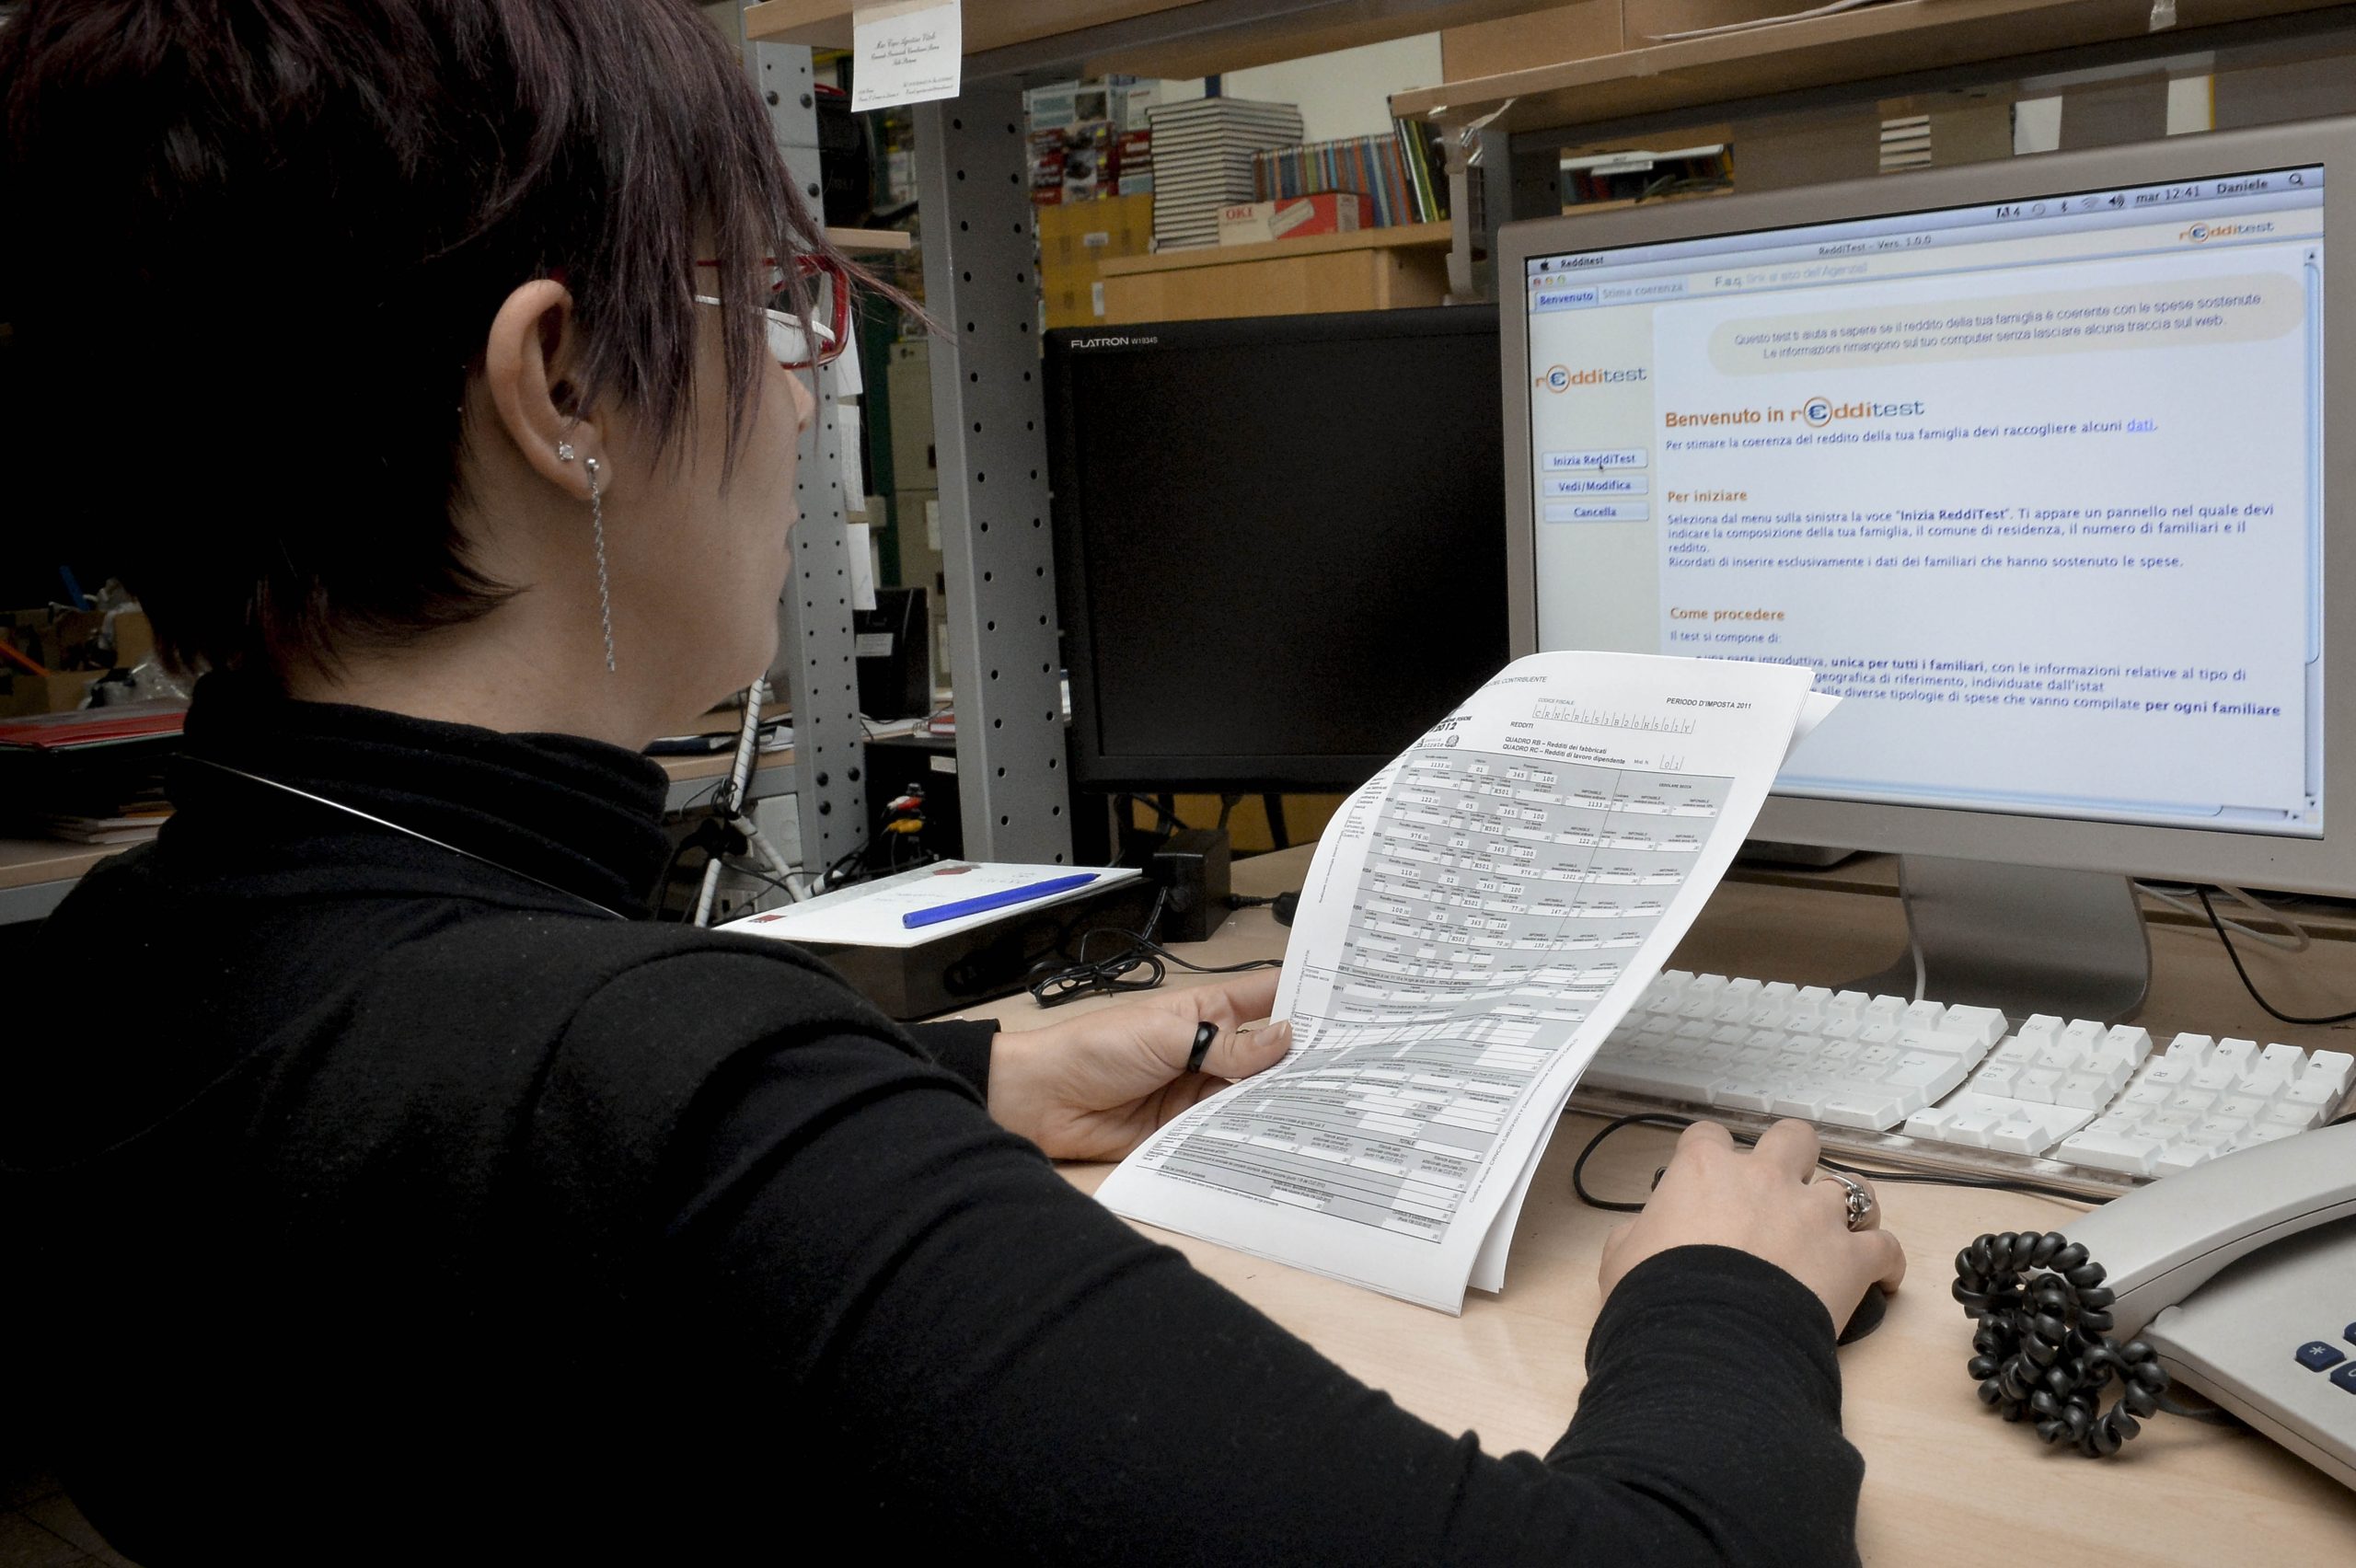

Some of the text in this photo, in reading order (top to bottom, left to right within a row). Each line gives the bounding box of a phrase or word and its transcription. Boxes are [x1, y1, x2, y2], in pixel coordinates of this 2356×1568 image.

[2136, 178, 2269, 204] mar 12:41 Daniele
[1225, 206, 1253, 221] OKI
[1539, 293, 1594, 306] Benvenuto
[1071, 337, 1129, 348] FLATRON
[1666, 408, 1761, 427] Benvenuto
[1767, 406, 1784, 423] in
[1665, 418, 2158, 450] Per stimare la coerenza del reddito della tua famiglia devi raccogliere alcuni dati.
[1553, 455, 1581, 466] Inizia
[1557, 480, 1632, 493] Vedi/Modifica
[1667, 489, 1748, 503] Per iniziare
[1574, 506, 1617, 517] Cancella
[1667, 513, 1718, 525] Seleziona
[1720, 513, 1738, 525] dal
[1740, 514, 1772, 524] menu
[1774, 511, 1802, 524] sulla
[1804, 512, 1848, 523] sinistra
[1851, 510, 1862, 523] la
[1865, 513, 1892, 522] voce
[2017, 507, 2030, 519] Ti
[2034, 509, 2080, 521] appare
[2084, 508, 2102, 518] un
[2106, 504, 2167, 520] pannello
[2171, 503, 2193, 517] nel
[2198, 503, 2239, 519] quale
[2243, 502, 2274, 516] devi
[1668, 528, 1710, 539] indicare
[1712, 526, 1723, 538] la
[1726, 527, 1803, 540] composizione
[1805, 525, 1834, 537] della
[1837, 527, 1856, 537] tua
[1915, 524, 1923, 536] il
[1927, 526, 1977, 536] comune
[1981, 524, 1992, 536] di
[1997, 523, 2065, 536] residenza,
[2069, 522, 2077, 535] il
[2082, 525, 2135, 535] numero
[2140, 522, 2153, 534] di
[2157, 521, 2218, 534] familiari
[2236, 520, 2246, 533] il
[1668, 556, 1715, 567] Ricordati
[1718, 556, 1728, 567] di
[1732, 557, 1774, 568] inserire
[1776, 556, 1864, 567] esclusivamente
[1875, 555, 1898, 567] dati
[1901, 556, 1920, 567] dei
[1924, 554, 1976, 567] familiari
[1980, 555, 2003, 567] che
[2006, 555, 2048, 567] hanno
[2051, 556, 2119, 567] sostenuto
[2122, 554, 2135, 567] le
[1669, 607, 1785, 622] Come procedere
[1669, 629, 1764, 645] Il test si compone
[1831, 656, 1865, 668] unica
[1867, 660, 1888, 670] per
[1891, 659, 1918, 670] tutti
[1991, 663, 2015, 673] con
[2018, 662, 2030, 674] le
[2034, 662, 2120, 676] informazioni
[2125, 664, 2177, 679] relative
[2181, 666, 2194, 679] al
[2199, 668, 2228, 683] tipo
[2232, 668, 2246, 681] di
[1814, 671, 1876, 685] geografica
[1878, 672, 1890, 684] di
[1971, 676, 2043, 690] individuate
[1666, 698, 1698, 707] PERIODO
[1699, 699, 1736, 709] D'IMPOSTA
[1844, 686, 2280, 716] diverse tipologie di spese che vanno compilate per ogni familiare
[1509, 721, 1534, 729] REDDITI
[1505, 736, 1531, 745] QUADRO
[1546, 741, 1568, 749] Redditi
[1579, 745, 1607, 755] fabbricati
[1502, 744, 1530, 753] QUADRO
[1592, 755, 1625, 764] dipendente
